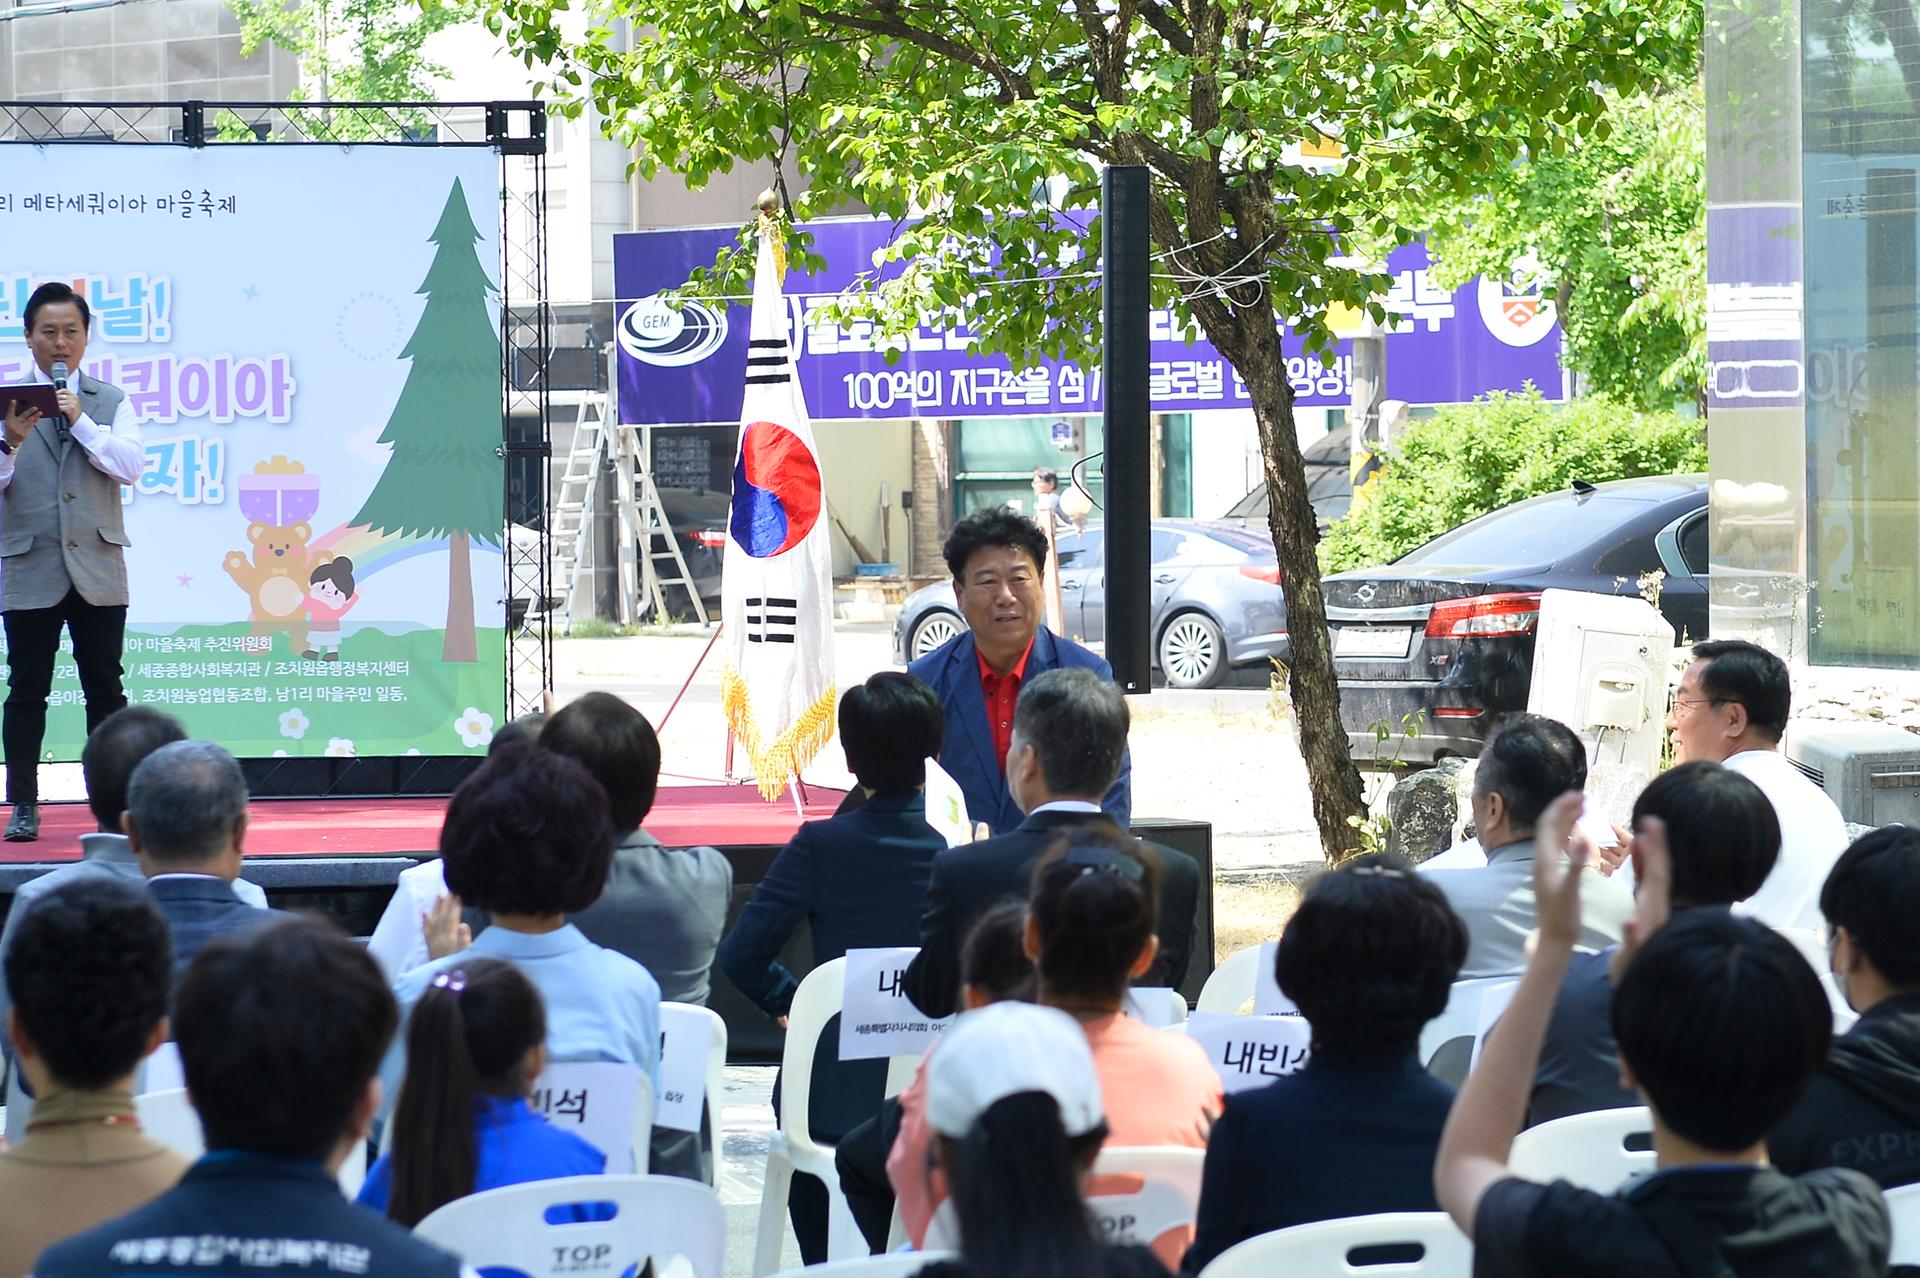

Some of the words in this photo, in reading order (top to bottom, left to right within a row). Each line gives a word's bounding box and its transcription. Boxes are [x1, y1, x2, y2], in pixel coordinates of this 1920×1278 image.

[24, 192, 147, 215] 메타세쿼이아
[156, 189, 236, 218] 마을축제
[642, 314, 671, 329] GEM
[843, 369, 942, 410] 100억의
[1149, 360, 1224, 401] 글로벌
[146, 637, 201, 653] 마을축제
[204, 635, 273, 652] 추진위원회
[138, 662, 262, 679] 세종종합사회복지관
[274, 660, 410, 677] 조치원읍행정복지센터
[275, 687, 312, 702] 남1리
[316, 686, 371, 702] 마을주민
[551, 1243, 613, 1263] TOP
